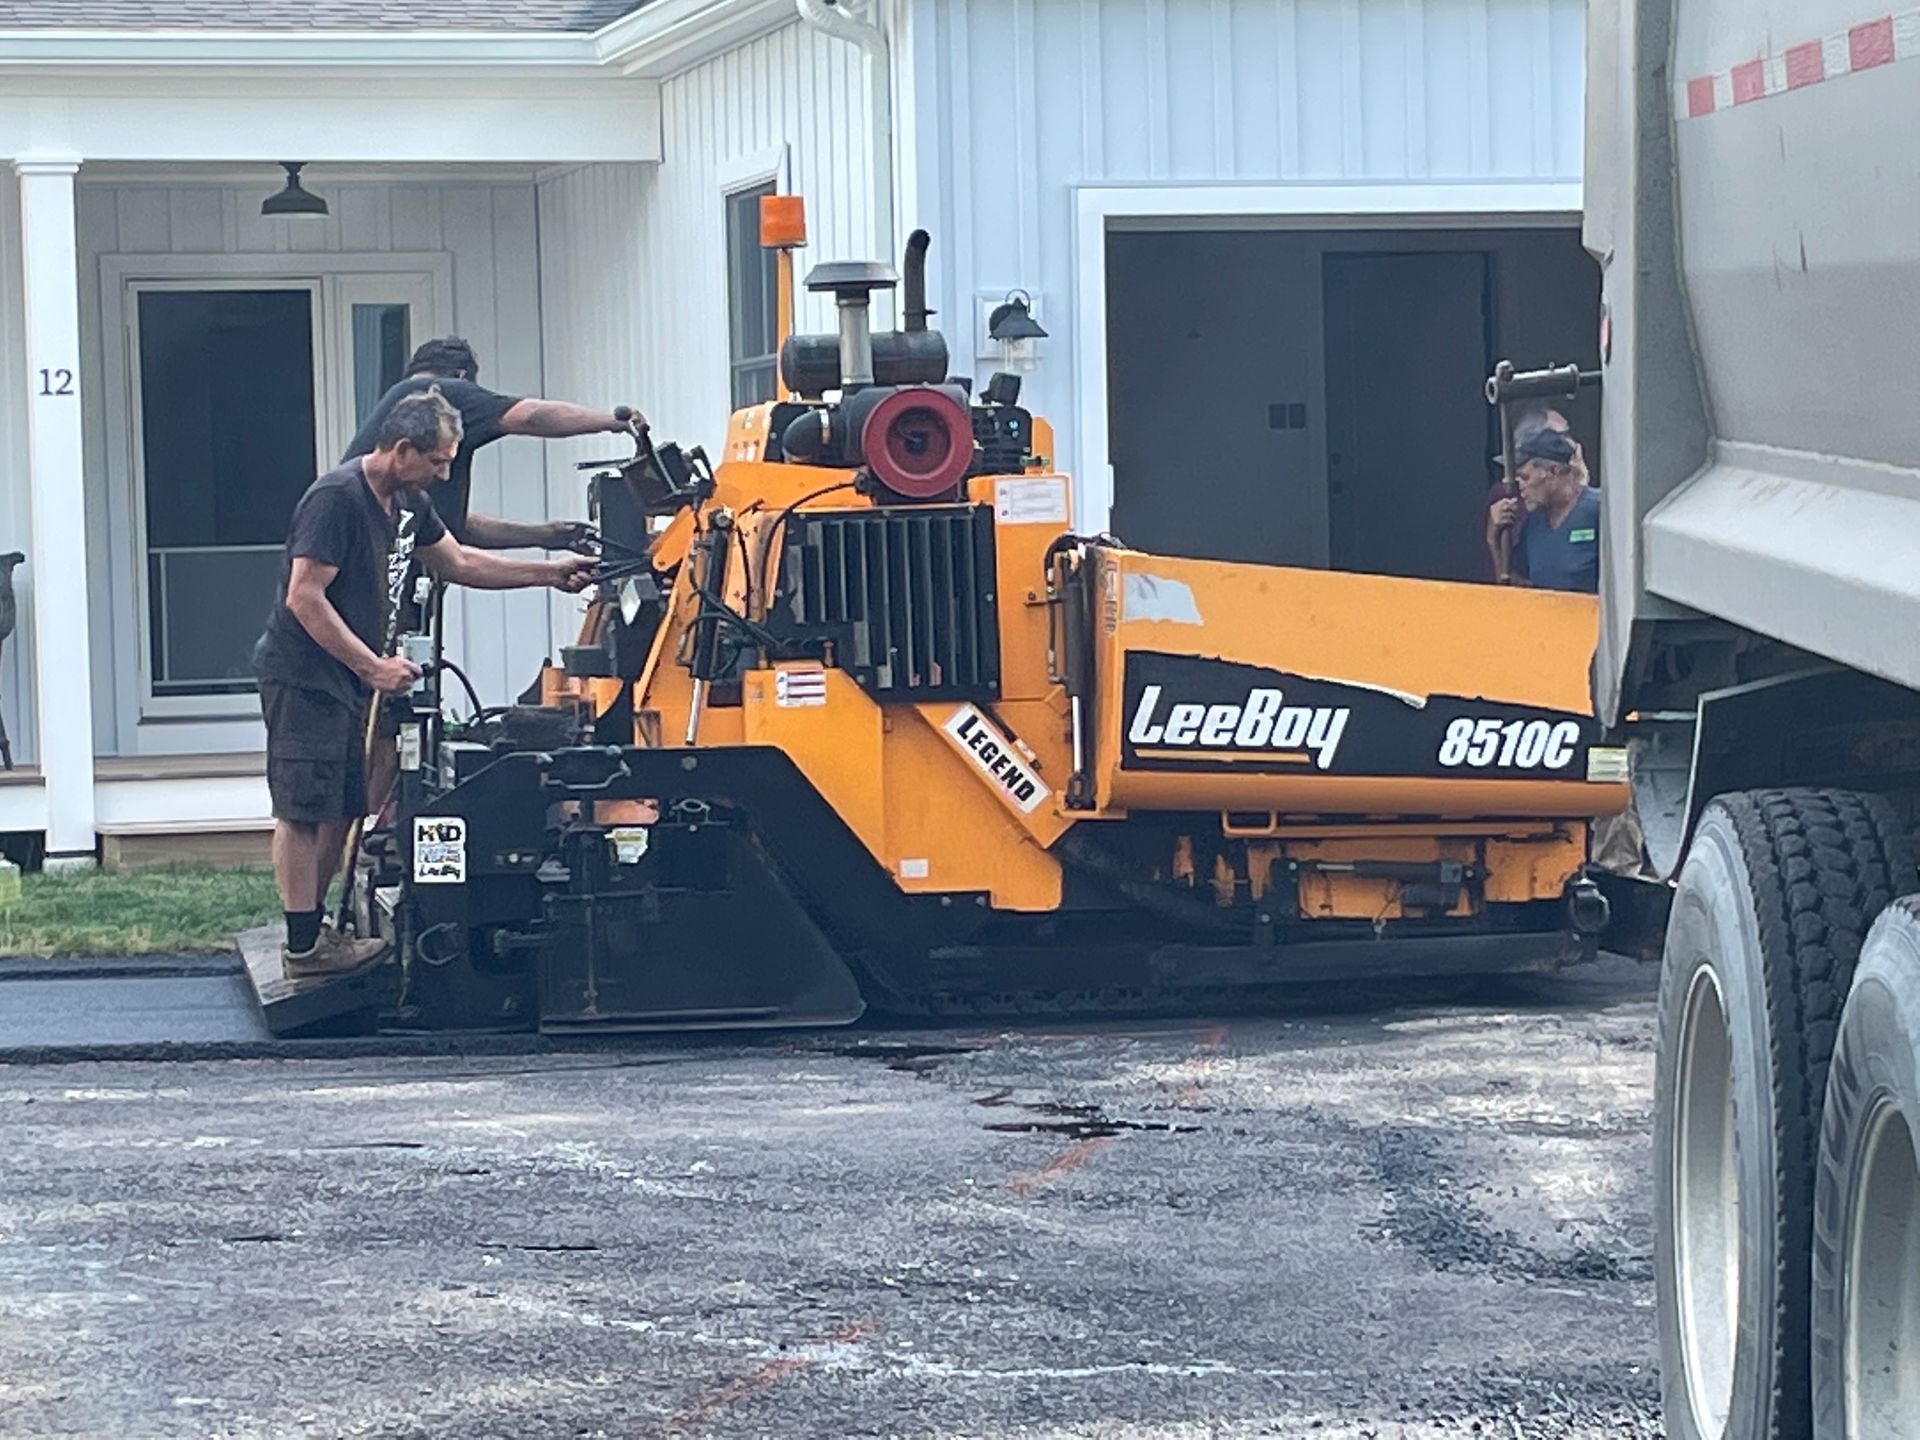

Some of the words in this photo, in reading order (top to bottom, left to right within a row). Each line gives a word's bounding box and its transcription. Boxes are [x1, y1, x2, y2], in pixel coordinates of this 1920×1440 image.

[39, 368, 74, 396] 12
[957, 714, 1035, 802] LEGEND
[1129, 685, 1350, 769] LeeBoy
[1438, 718, 1580, 769] 8510C
